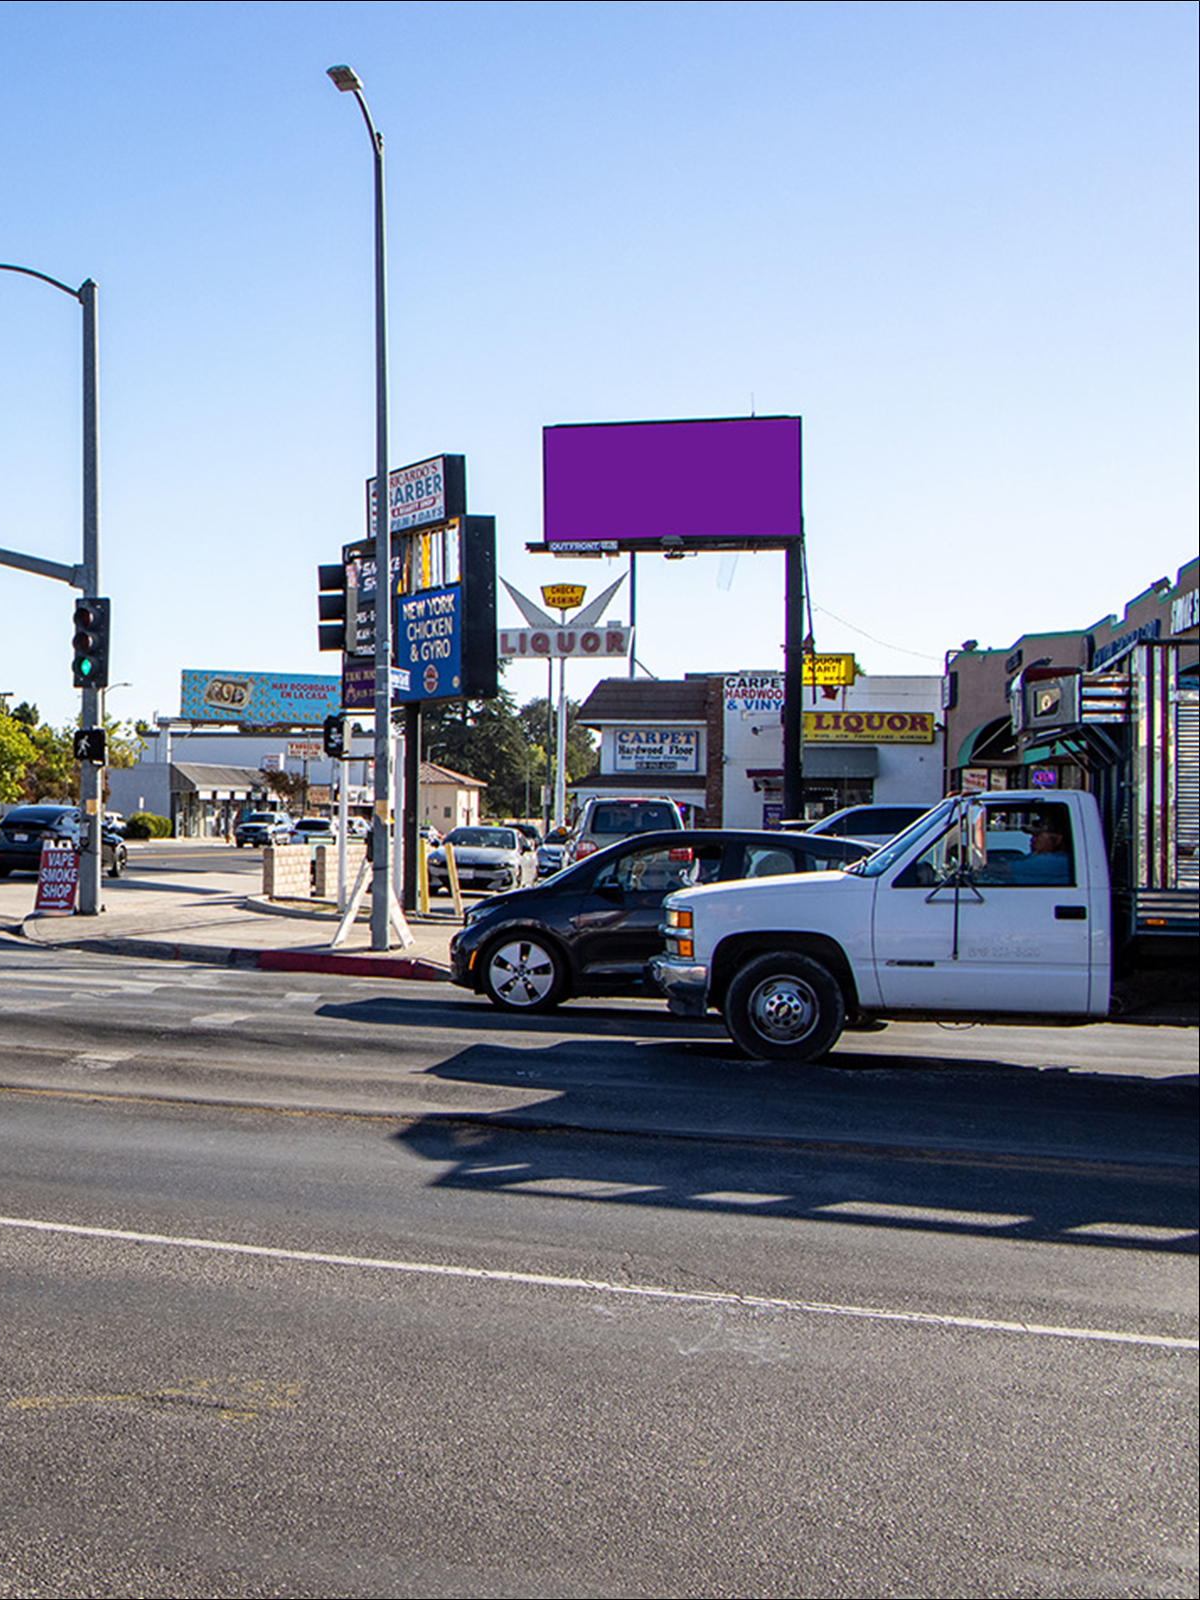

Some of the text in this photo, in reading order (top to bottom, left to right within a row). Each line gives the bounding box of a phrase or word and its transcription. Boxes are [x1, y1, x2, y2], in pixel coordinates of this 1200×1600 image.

[390, 506, 443, 530] PEN 7 DAYS
[550, 541, 601, 552] OUTFRONT
[550, 585, 575, 595] CHECK
[403, 597, 425, 621] NEW
[427, 593, 456, 617] YORK
[547, 596, 580, 605] CASHING
[407, 617, 453, 642] CHICKEN
[410, 638, 451, 662] & GYRO
[500, 631, 625, 656] LIQUOR
[305, 691, 328, 700] CASA
[727, 700, 738, 711] &
[813, 714, 930, 734] LIQUOR
[618, 731, 694, 744] CARPET
[618, 745, 694, 755] Hardwood Floor
[48, 852, 75, 867] VAPE
[40, 868, 78, 882] SMOKE
[41, 883, 72, 898] SHOP
